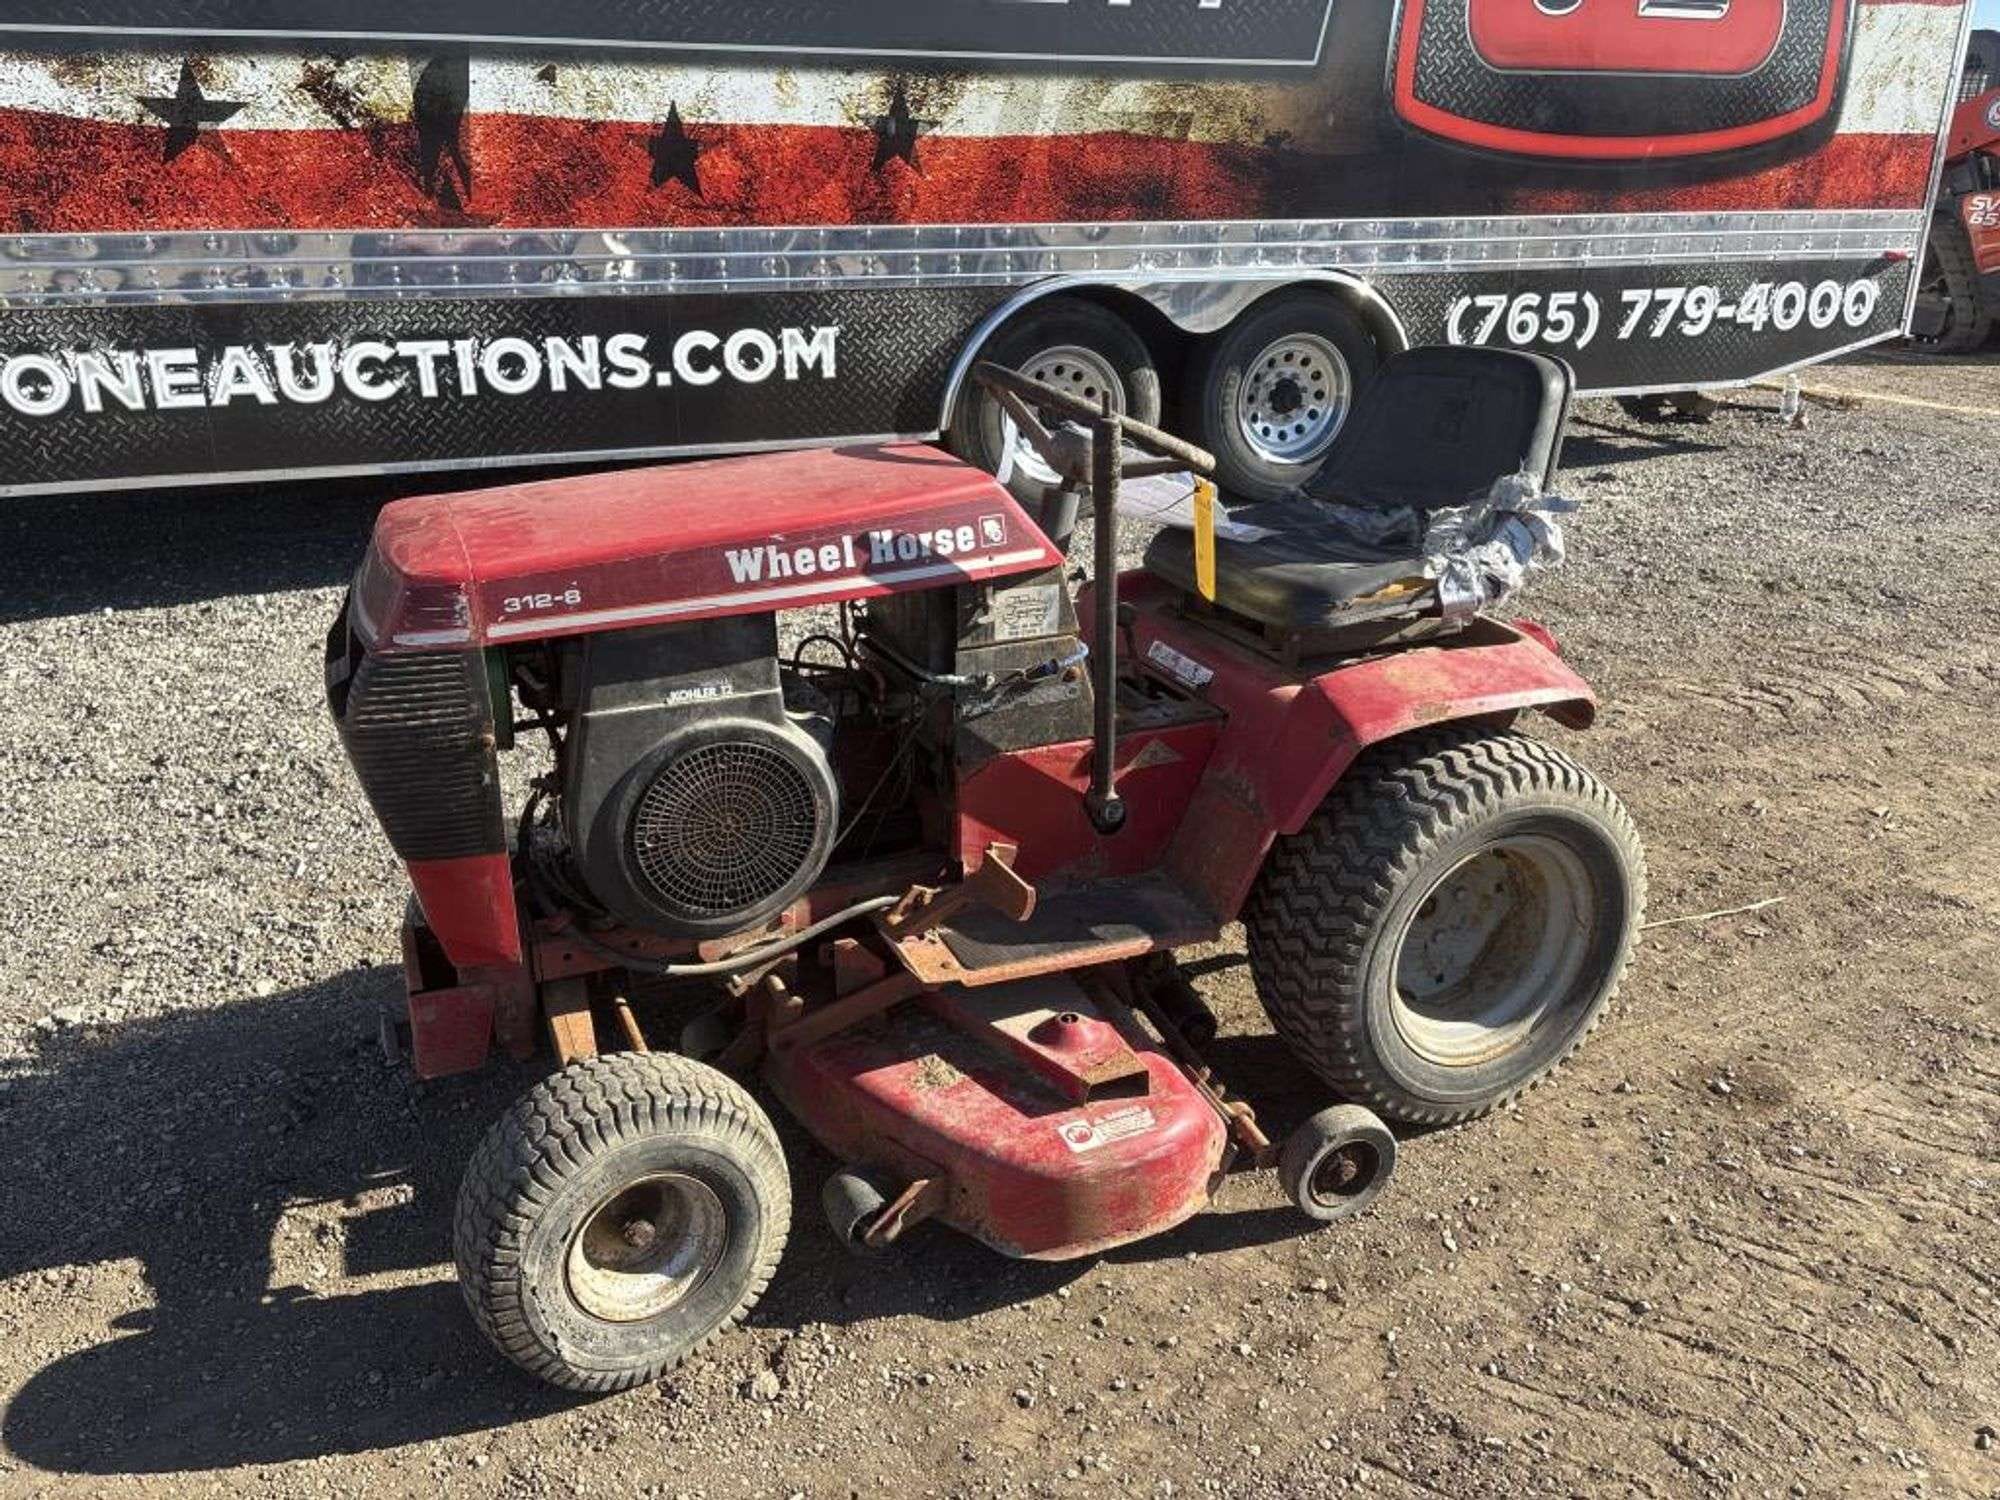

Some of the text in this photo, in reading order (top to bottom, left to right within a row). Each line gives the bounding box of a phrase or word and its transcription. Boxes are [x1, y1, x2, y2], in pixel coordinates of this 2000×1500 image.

[1447, 279, 1880, 350] (765) 779-4000
[0, 326, 839, 415] ONEAUCTIONS.COM
[724, 525, 976, 583] Wheel Horse
[503, 589, 582, 612] 312-8
[669, 687, 717, 702] KOHLER
